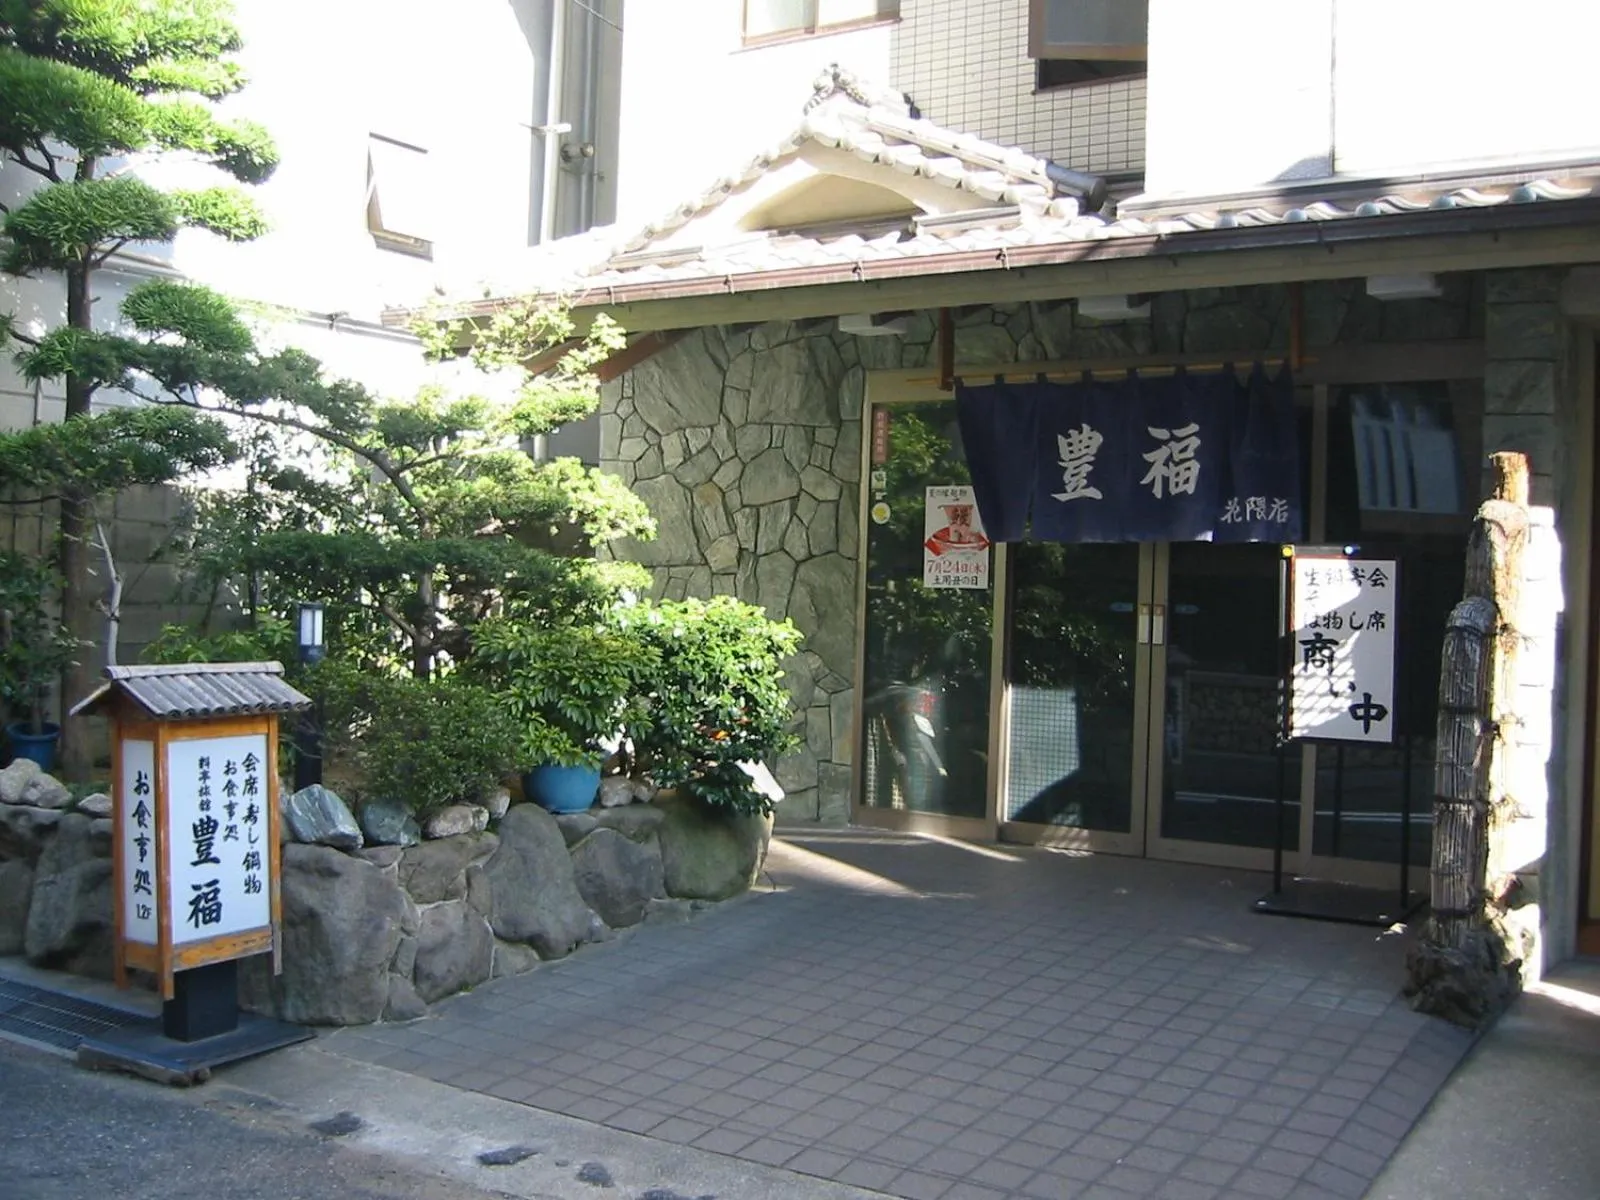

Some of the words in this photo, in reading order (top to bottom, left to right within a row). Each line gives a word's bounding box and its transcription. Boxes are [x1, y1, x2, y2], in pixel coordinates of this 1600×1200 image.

[1051, 422, 1202, 502] 豊福
[132, 770, 153, 896] お食事処
[222, 759, 240, 842] お食事処
[186, 815, 224, 930] 豊福
